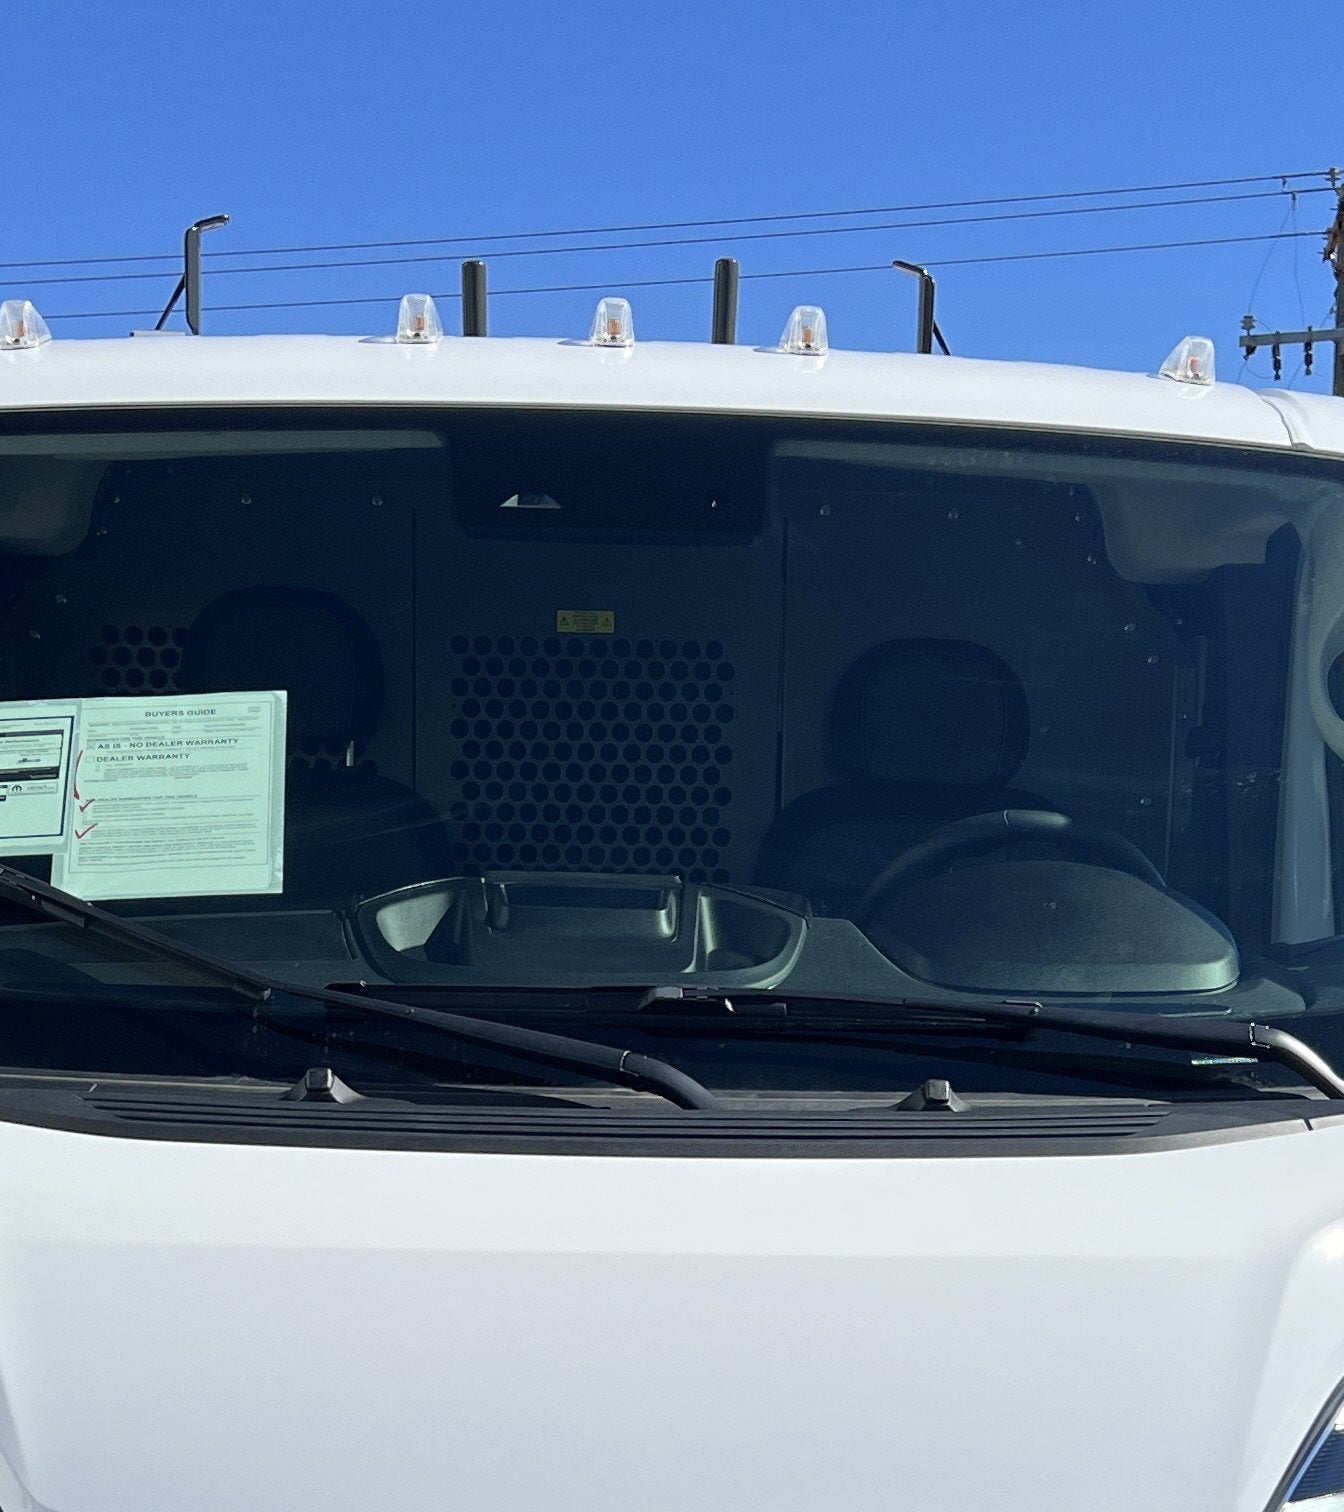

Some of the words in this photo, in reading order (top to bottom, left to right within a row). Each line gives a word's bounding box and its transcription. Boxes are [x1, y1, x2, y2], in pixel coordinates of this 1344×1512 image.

[144, 710, 185, 718] BUYERS
[186, 708, 217, 716] GUIDE
[145, 740, 183, 748] DEALER
[185, 738, 239, 747] WARRANTY
[96, 755, 134, 763] DEALER
[136, 753, 191, 761] WARRANTY
